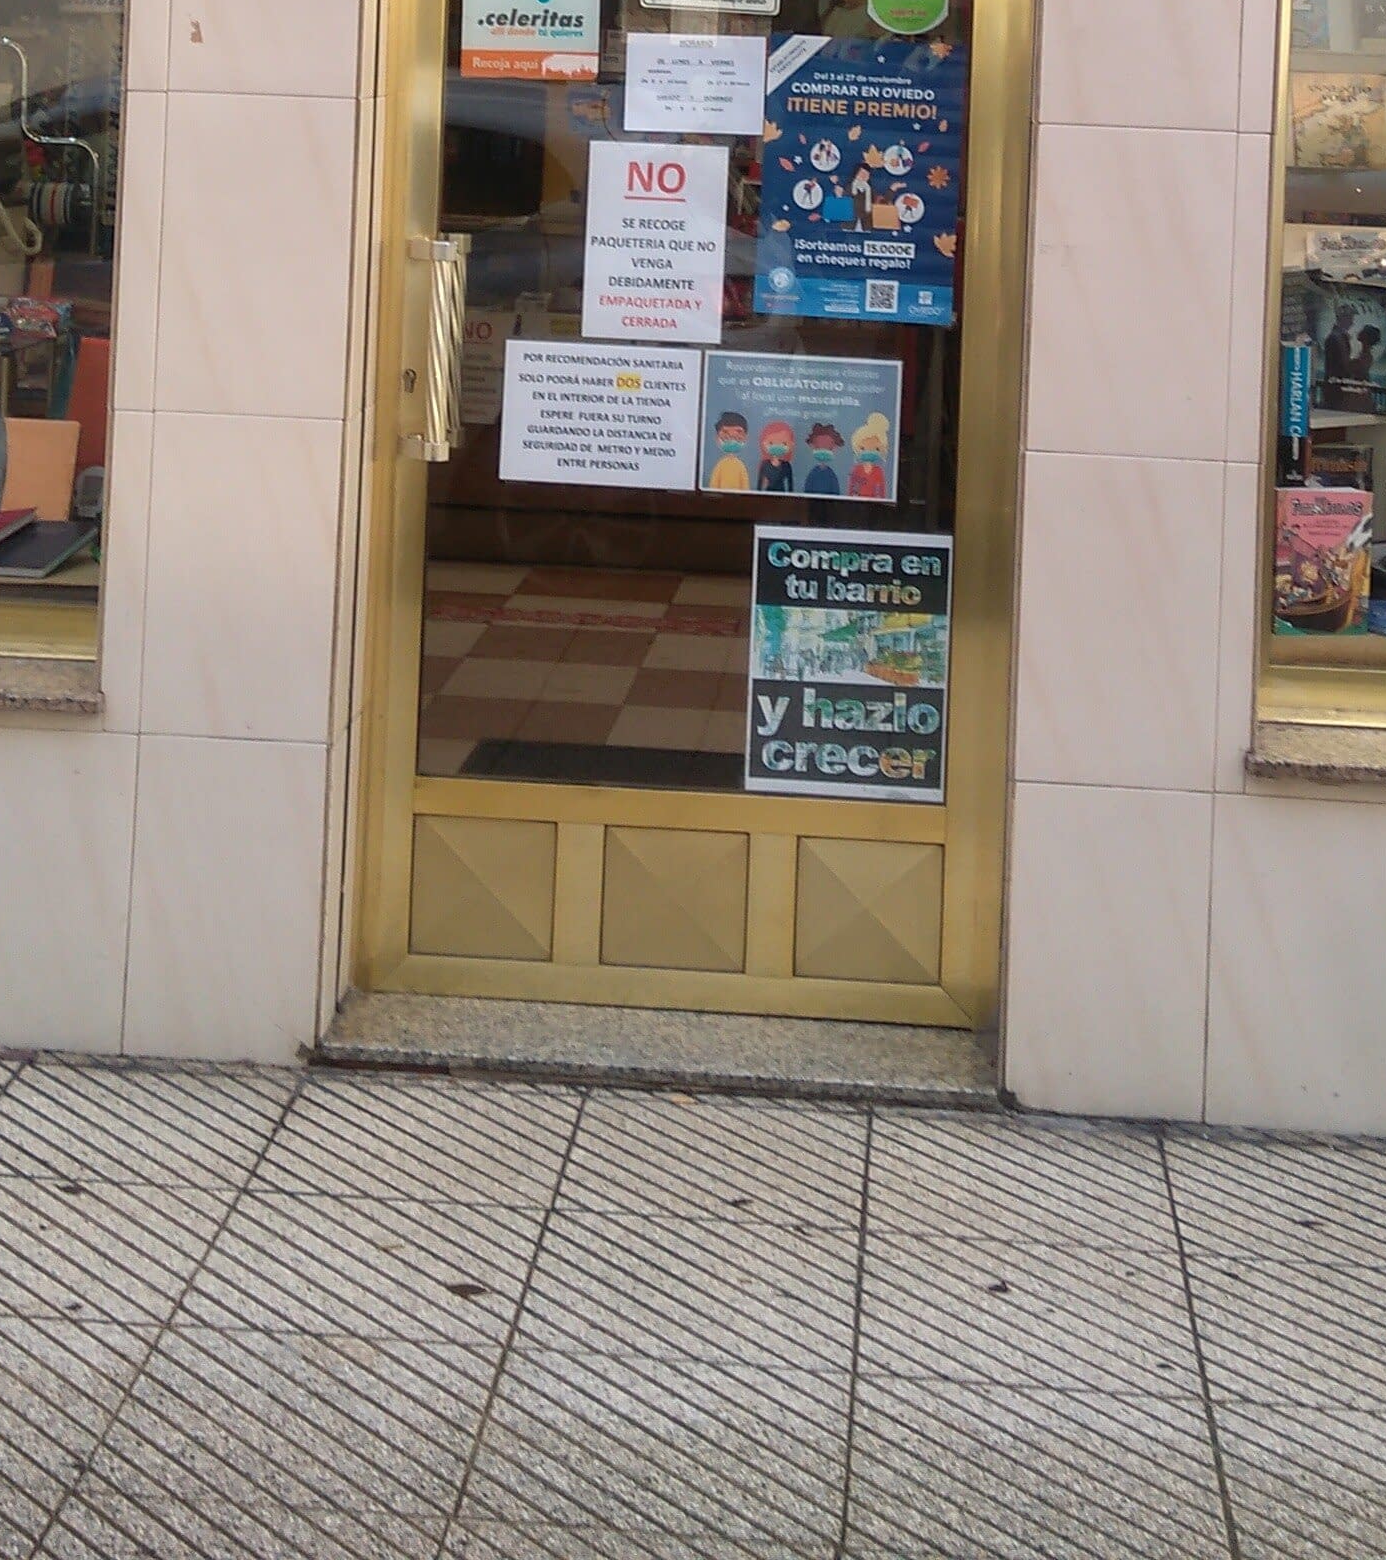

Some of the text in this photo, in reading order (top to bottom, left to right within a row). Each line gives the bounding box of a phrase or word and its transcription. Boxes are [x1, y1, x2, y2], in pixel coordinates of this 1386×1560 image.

[791, 82, 935, 101] COMPRAR EN OVIEDO
[853, 101, 938, 120] PREMIO!
[627, 160, 687, 194] NO
[622, 218, 686, 231] SE RECOGE
[590, 236, 716, 252] PAQUETERIA QUE NO
[631, 257, 673, 270] VENGA
[815, 253, 866, 269] cheques
[608, 276, 695, 290] DEBIDAMENTE
[599, 295, 703, 310] EMPAQUETADA Y
[622, 315, 677, 329] CERRADA
[523, 353, 684, 371] POR RECOMENDACIÓN SANITARIA
[518, 372, 687, 392] SOLO PODRÁ HABER DOS CLIENTES
[752, 376, 844, 392] OBLIGATORIO
[533, 391, 671, 408] EN EL INTERIOR DE LA TIENDA
[541, 410, 662, 425] ESPERE FUERA SU TURNO
[527, 424, 672, 441] GUARDANDO LA DISTANCIA DE
[522, 440, 676, 457] SEGURIDAD DE METRO Y MEDIO
[557, 458, 639, 471] ENTRE PERSONAS
[767, 541, 942, 577] Compra en
[785, 573, 922, 606] tu barrio
[757, 687, 940, 737] y hazlo
[762, 739, 937, 780] crecer
